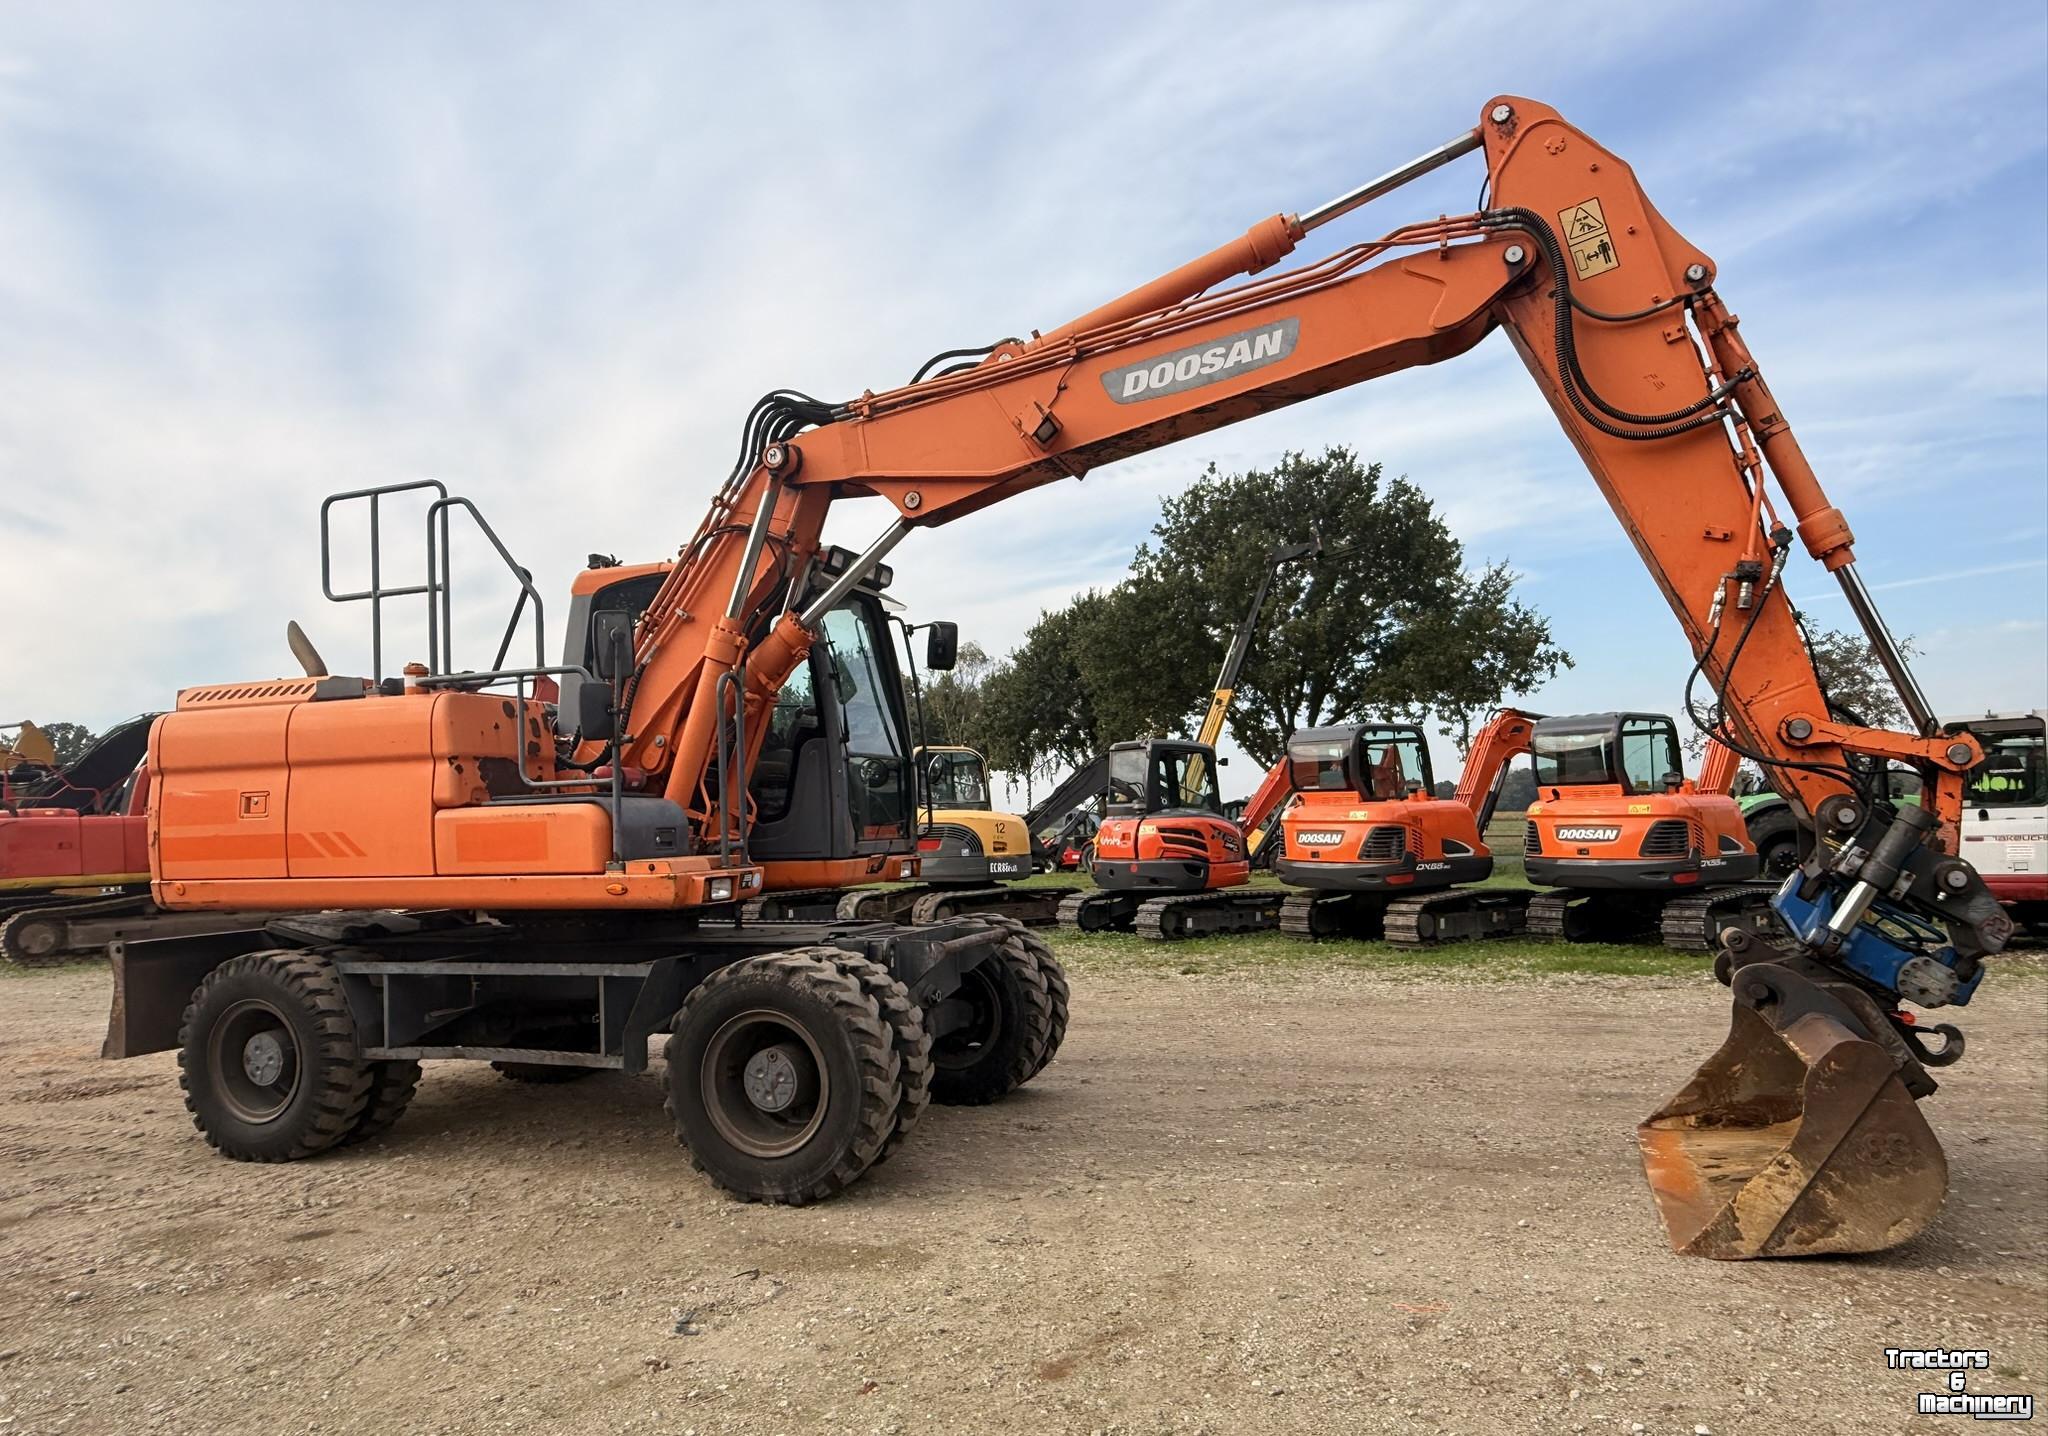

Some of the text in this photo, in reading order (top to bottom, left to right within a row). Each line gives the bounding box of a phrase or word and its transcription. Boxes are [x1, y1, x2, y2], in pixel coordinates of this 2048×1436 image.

[1123, 329, 1283, 397] DOOSAN
[995, 822, 1005, 833] 12
[1298, 833, 1342, 844] DOOSAN
[1559, 829, 1618, 840] DOOSAN
